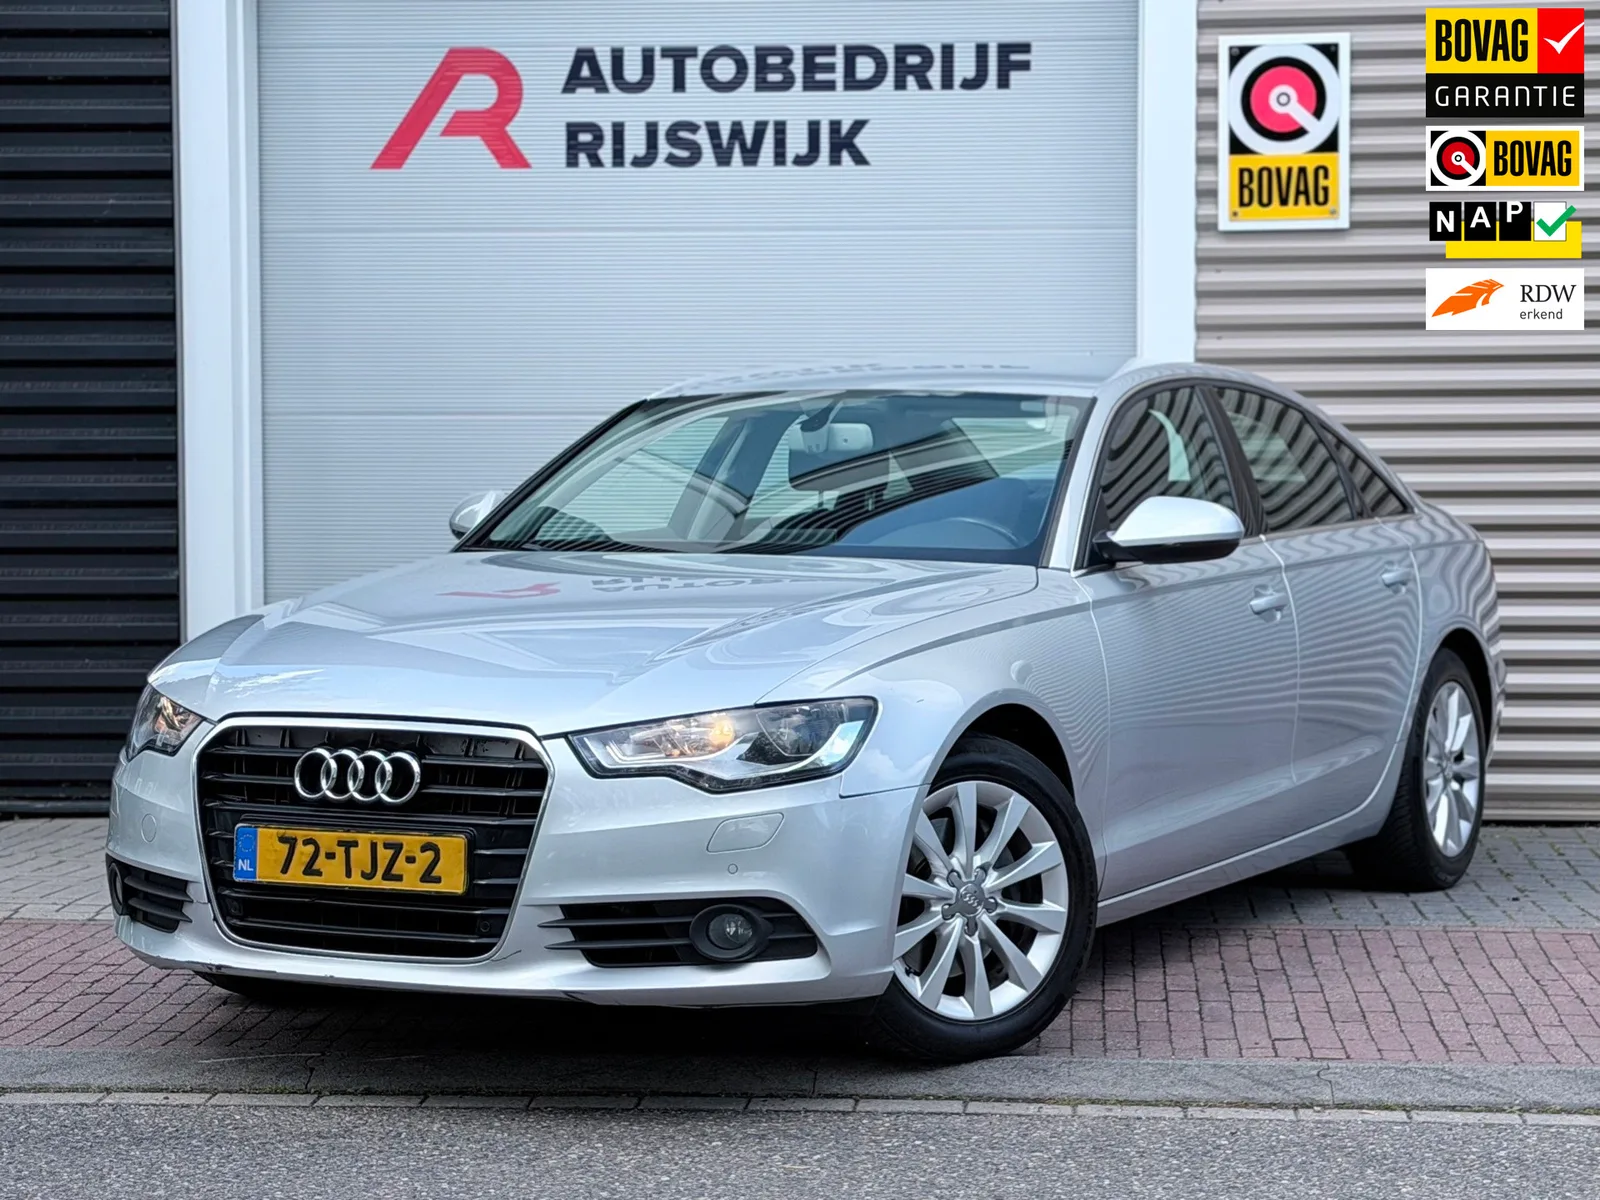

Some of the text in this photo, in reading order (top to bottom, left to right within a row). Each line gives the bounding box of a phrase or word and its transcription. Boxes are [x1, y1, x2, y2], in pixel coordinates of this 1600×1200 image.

[561, 42, 1032, 94] AUTOBEDRIJF
[565, 119, 870, 168] RIJSWIJK
[1238, 165, 1329, 208] BOVAG
[238, 858, 254, 872] NL
[278, 835, 442, 884] 72-TJZ-2
